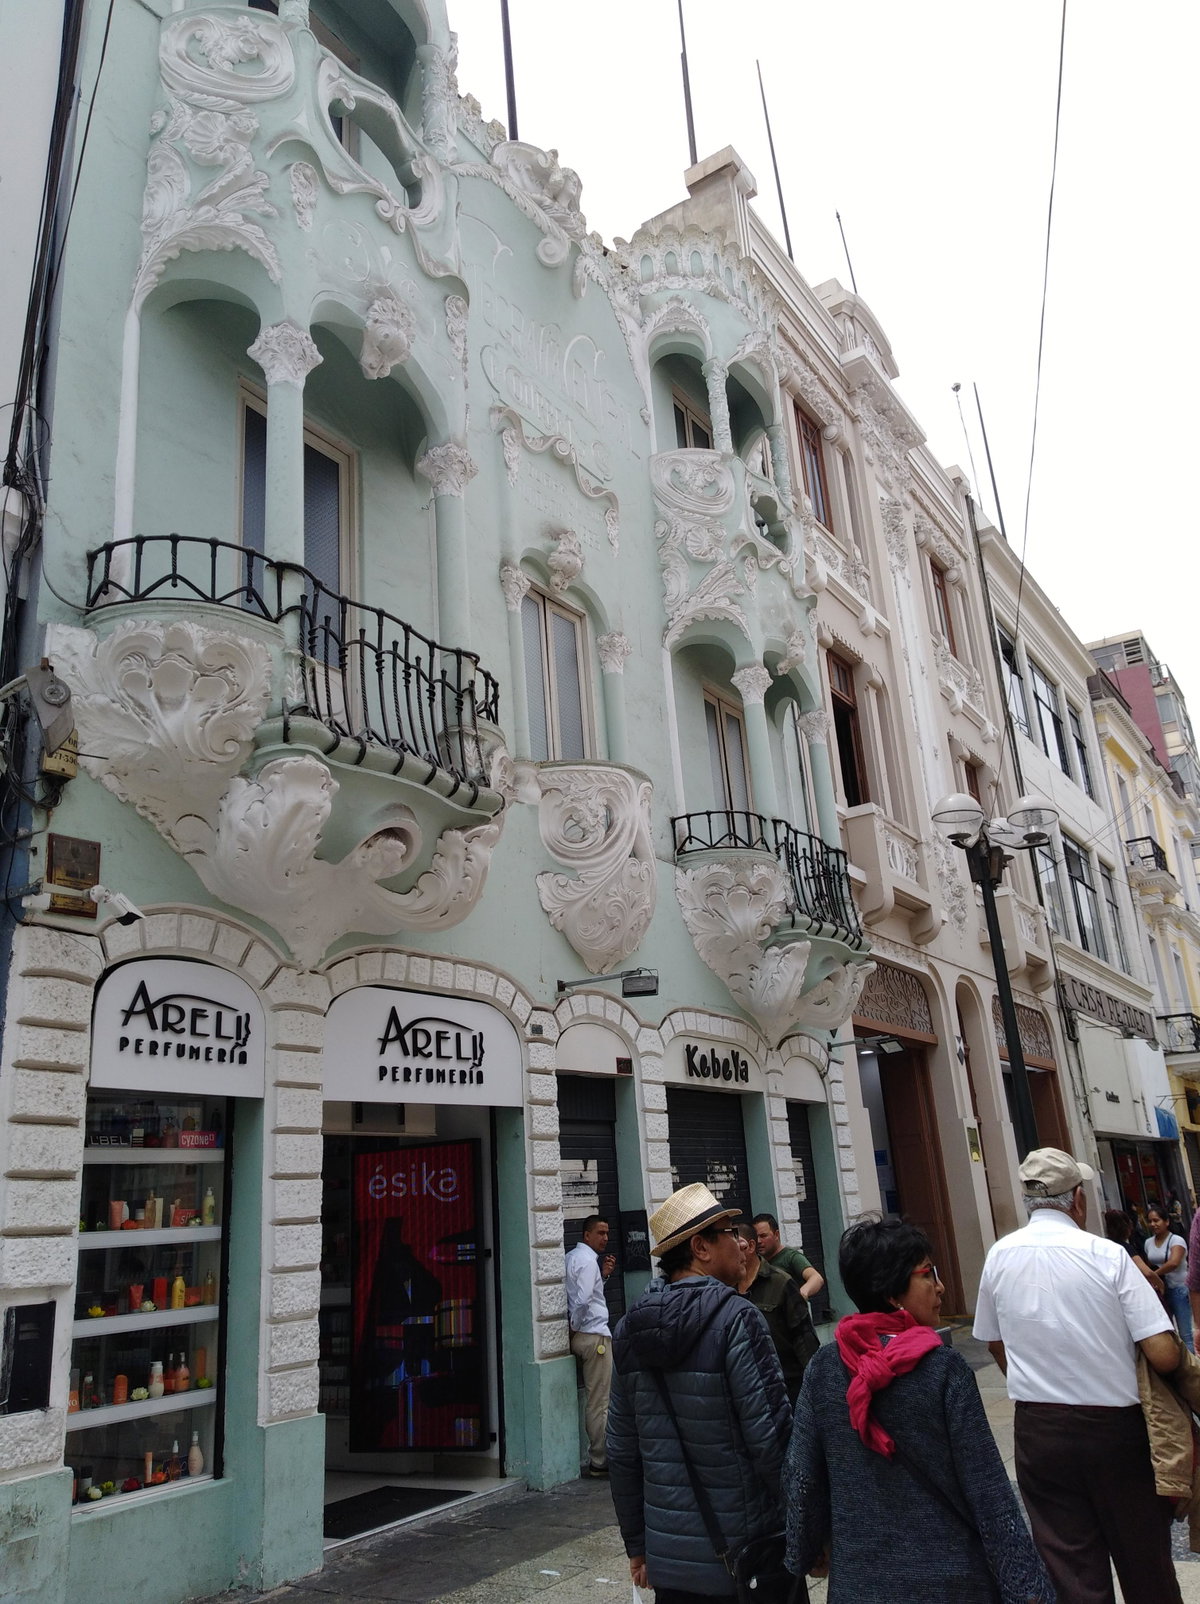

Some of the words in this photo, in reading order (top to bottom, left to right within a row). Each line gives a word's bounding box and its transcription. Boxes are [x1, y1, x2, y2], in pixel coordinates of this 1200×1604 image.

[121, 980, 251, 1043] ARELI
[1071, 979, 1106, 1018] CASA
[377, 1005, 485, 1064] ARELI
[378, 1065, 484, 1085] PERFUMERÍA
[368, 1162, 460, 1202] ésika
